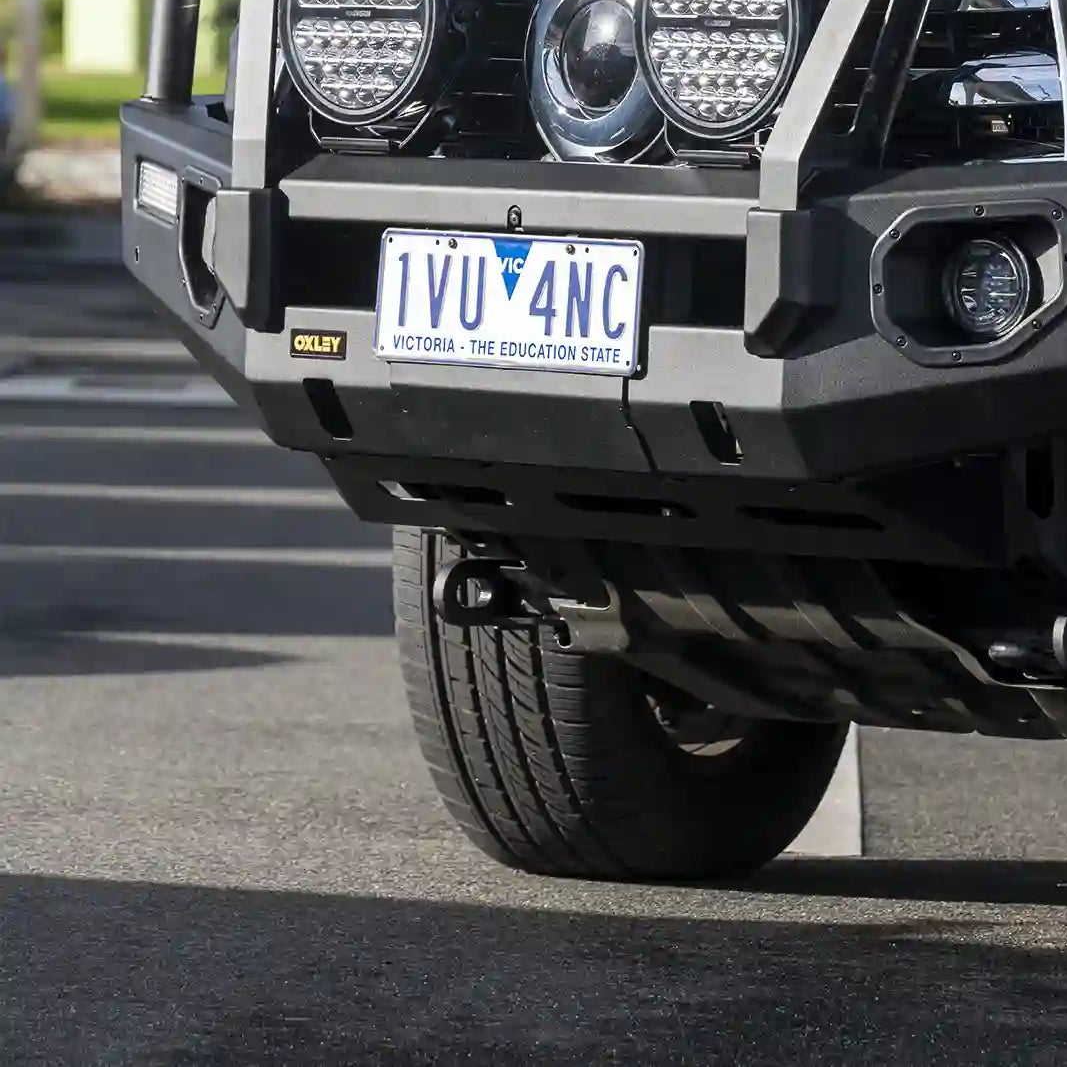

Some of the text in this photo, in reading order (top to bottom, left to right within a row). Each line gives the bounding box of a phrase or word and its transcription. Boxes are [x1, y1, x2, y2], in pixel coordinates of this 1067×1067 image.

[497, 256, 525, 275] VIC
[398, 251, 628, 340] 1VU 4NC
[294, 334, 341, 353] OXLEY
[393, 334, 455, 353] VICTORIA
[470, 339, 495, 356] THE
[500, 341, 576, 361] EDUCATION
[581, 346, 621, 364] STATE
